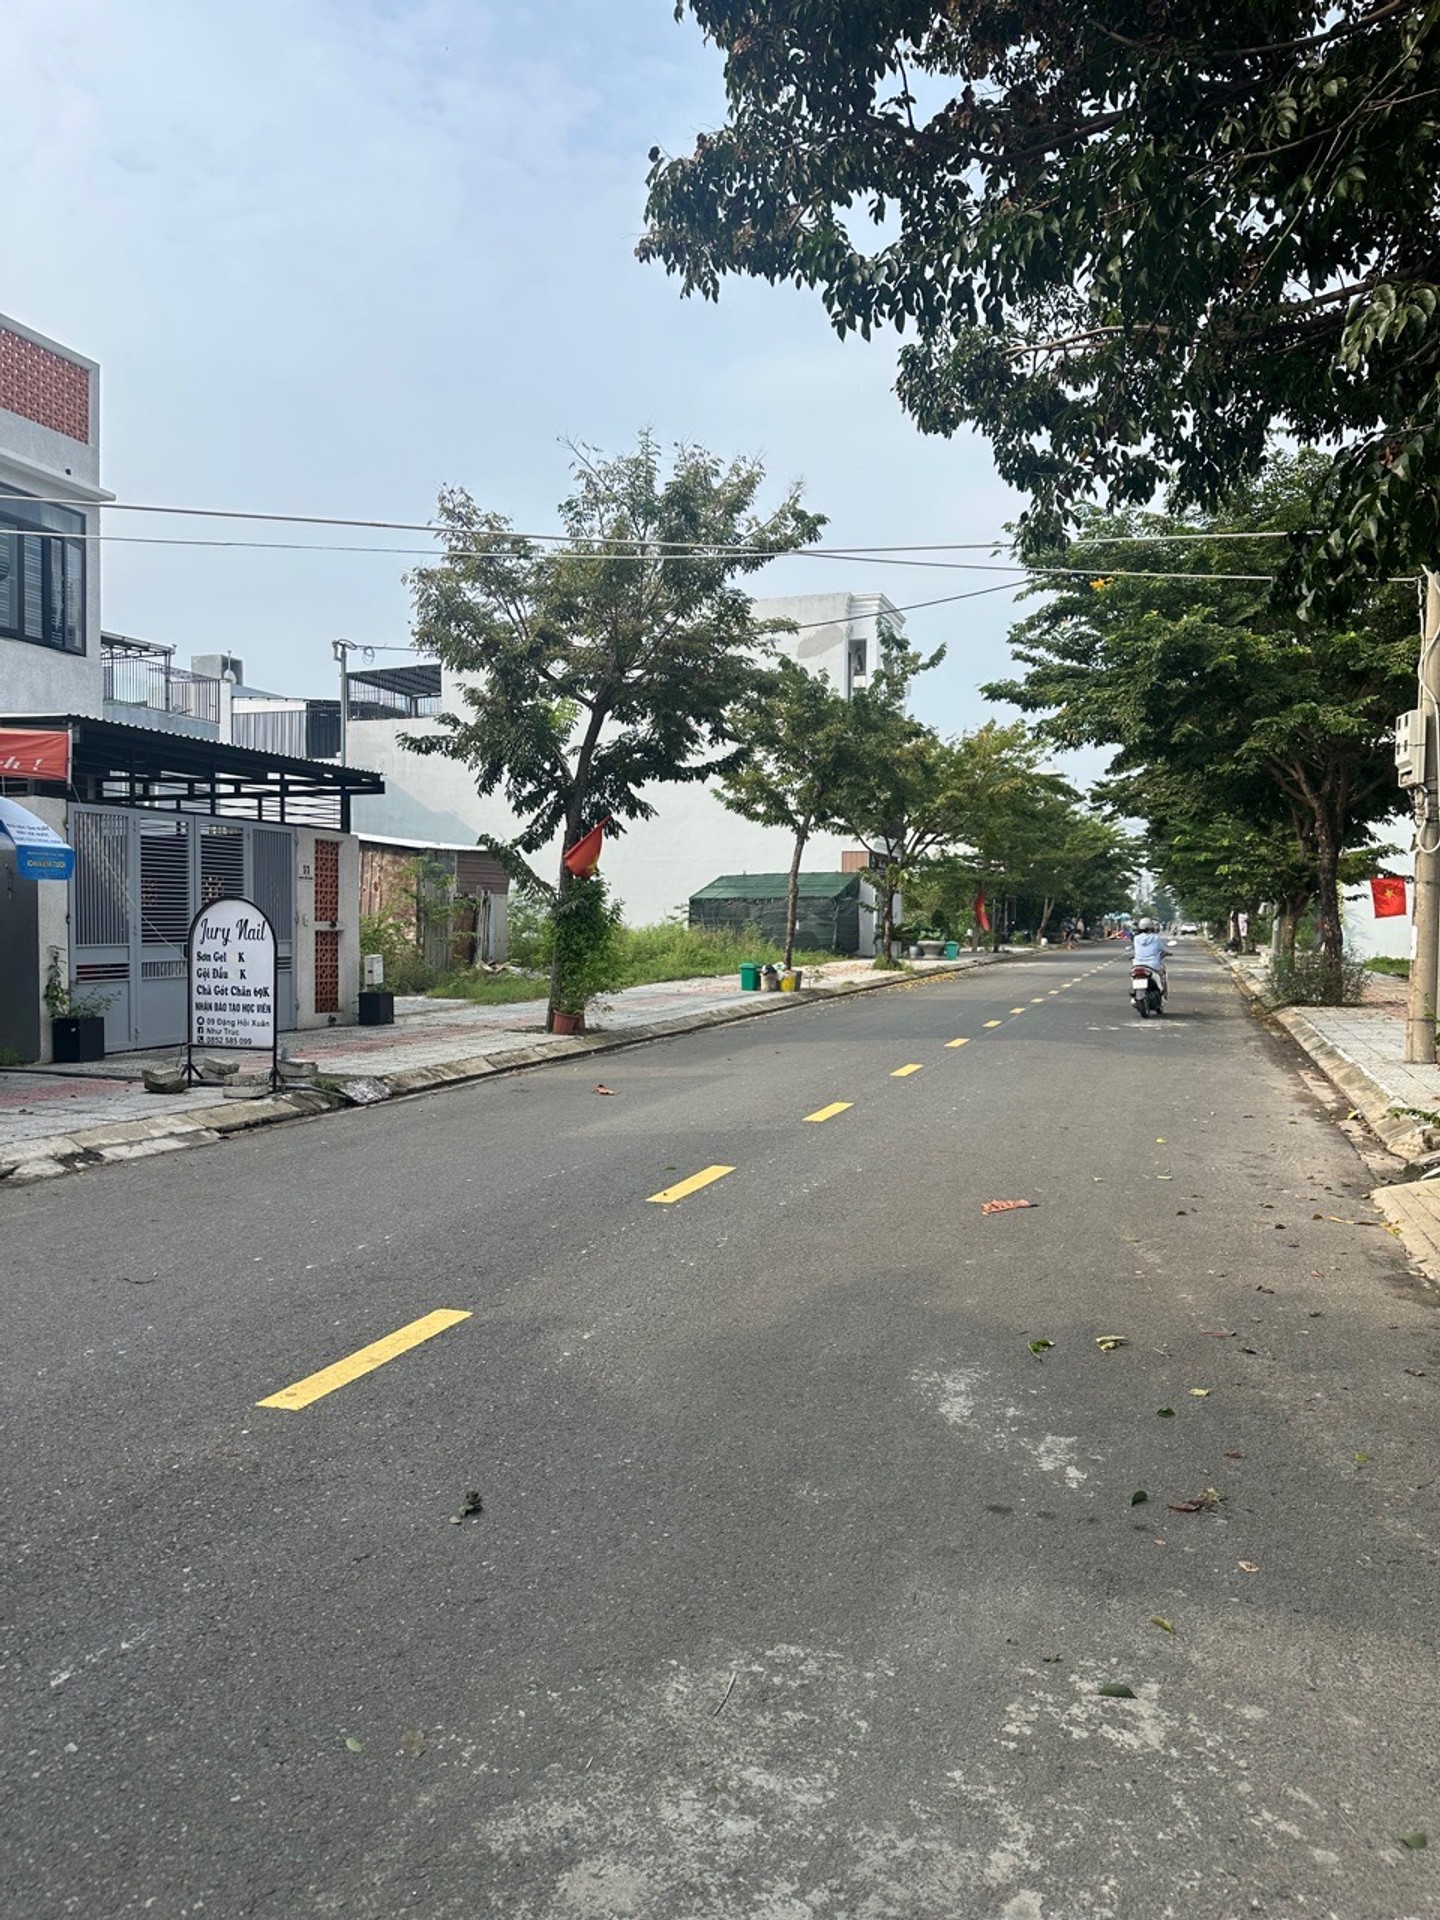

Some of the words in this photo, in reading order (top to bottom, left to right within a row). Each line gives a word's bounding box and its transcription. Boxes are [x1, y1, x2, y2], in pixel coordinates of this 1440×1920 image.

[199, 918, 232, 946] Jury
[236, 918, 266, 941] Nail
[213, 951, 227, 962] Gel
[238, 952, 245, 963] K
[239, 968, 247, 980] K
